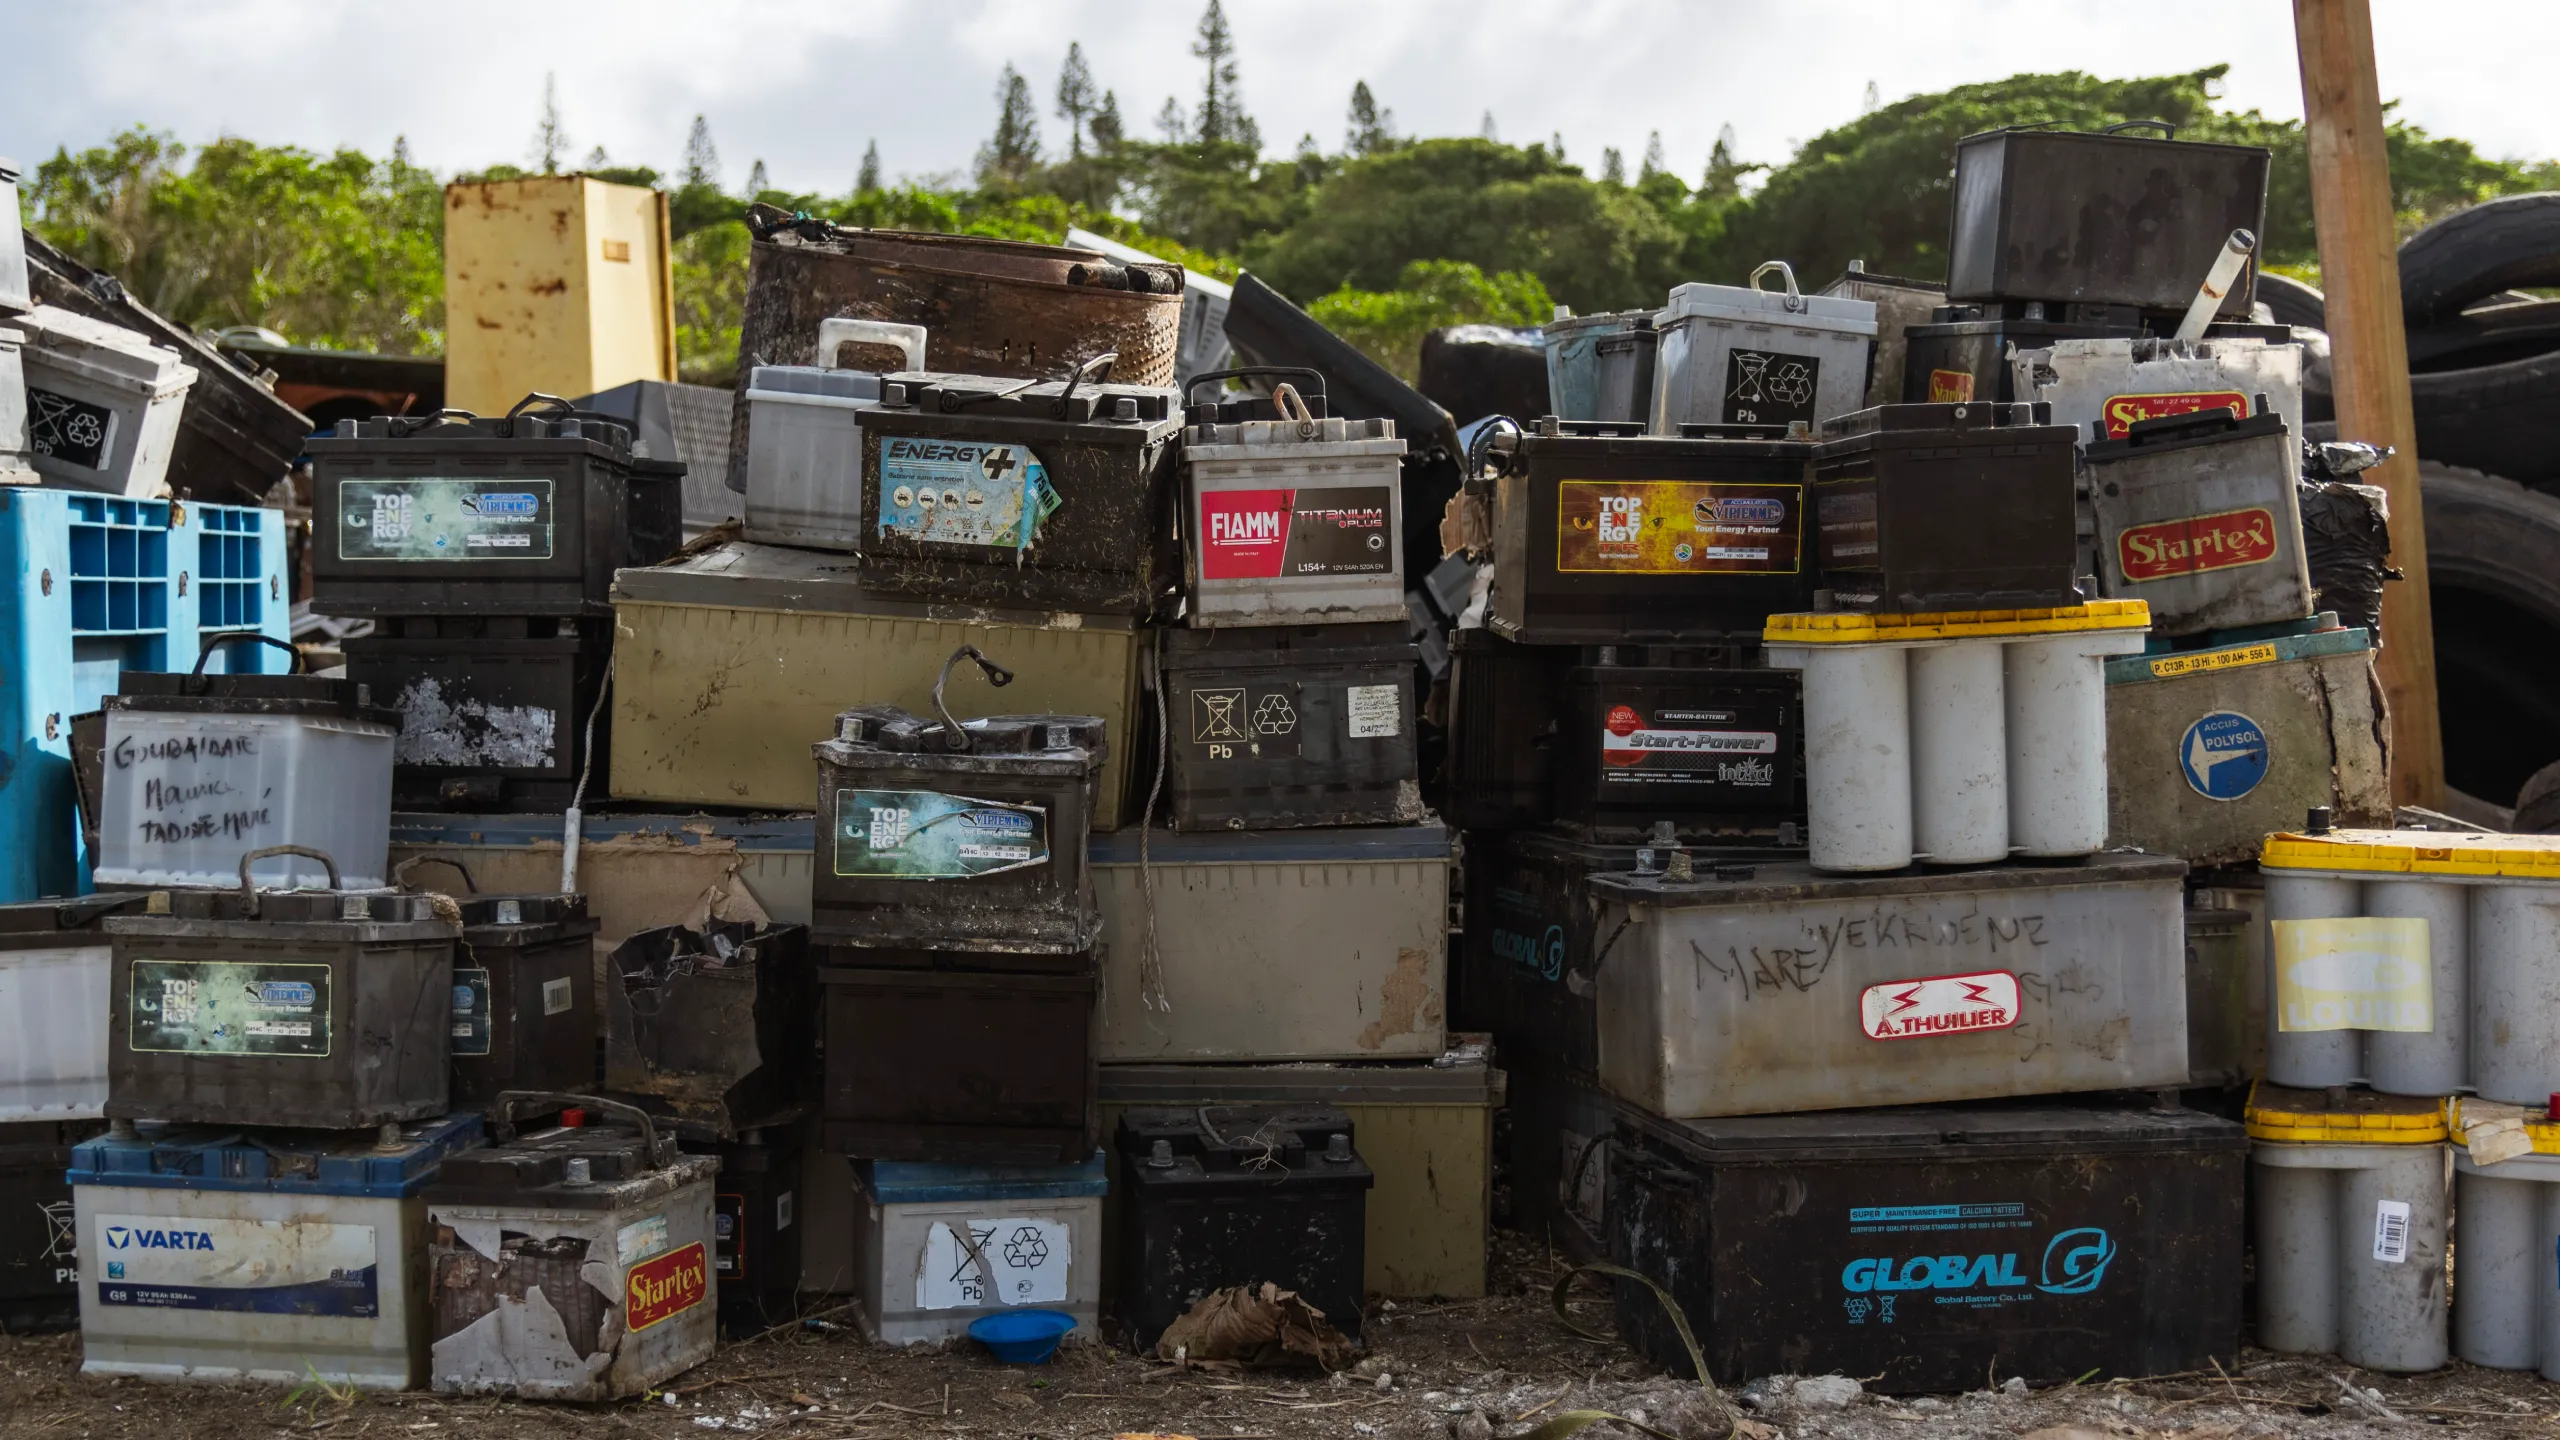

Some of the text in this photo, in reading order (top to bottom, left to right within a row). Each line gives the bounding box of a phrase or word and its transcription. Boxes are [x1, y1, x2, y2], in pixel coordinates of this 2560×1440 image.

[1737, 408, 1757, 423] Pb
[34, 439, 54, 456] Pb
[372, 494, 414, 509] TOP
[1599, 497, 1642, 512] TOP
[372, 509, 414, 523] ENE
[507, 515, 536, 523] Partner
[1715, 504, 1776, 520] VIPIEMME
[1211, 511, 1280, 539] FIAMM
[1599, 512, 1641, 527] ENE
[372, 523, 412, 538] RGY
[1599, 527, 1640, 541] RGY
[1694, 525, 1780, 534] Your Energy Partner
[1598, 543, 1640, 551] TIR
[2128, 518, 2268, 565] Startex
[1298, 563, 1326, 572] L154+
[2164, 660, 2185, 672] C13R
[2191, 659, 2200, 668] 13
[2217, 654, 2231, 665] 100
[2250, 649, 2264, 660] 556
[2265, 647, 2271, 657] A
[1612, 711, 1634, 720] NEW
[1663, 713, 1728, 721] STARTER-BATTERIE
[2204, 718, 2240, 732] ACCUS
[1629, 732, 1766, 750] Start-Power
[2206, 730, 2260, 749] POLYSOL
[1209, 744, 1233, 759] Pb
[869, 807, 911, 822] TOP
[974, 814, 1027, 827] VIPIEMME
[869, 822, 909, 835] ENE
[977, 829, 1003, 837] Energy
[1004, 829, 1032, 838] Partner
[869, 835, 906, 849] RGY
[162, 979, 199, 995] TOP
[285, 1005, 313, 1013] Partner
[2287, 1001, 2429, 1027] LOURD
[1852, 1210, 1881, 1218] SUPER
[1962, 1206, 1992, 1215] CALCIUM
[1993, 1206, 2022, 1214] BATTERY
[134, 1228, 215, 1251] VARTA
[55, 1267, 80, 1283] Pb
[330, 1269, 364, 1281] BLUE
[1841, 1253, 2027, 1292] GLOBAL
[630, 1252, 704, 1313] Startex
[109, 1290, 128, 1301] G8
[962, 1286, 983, 1300] Pb
[1934, 1296, 1963, 1304] Global
[1965, 1295, 1998, 1304] Battery
[2018, 1292, 2035, 1300] Ltd.
[1882, 1316, 1893, 1324] Pb
